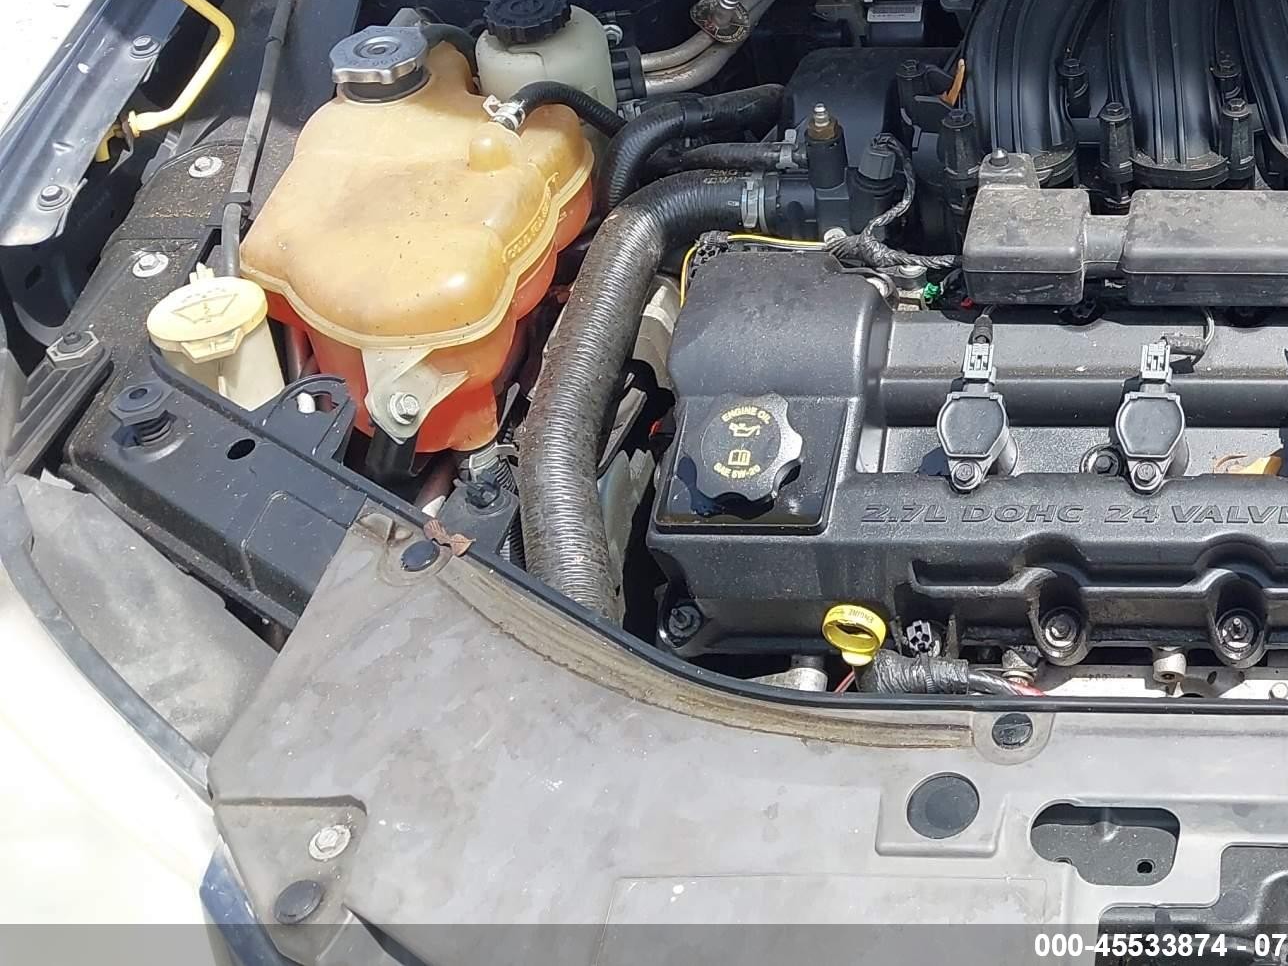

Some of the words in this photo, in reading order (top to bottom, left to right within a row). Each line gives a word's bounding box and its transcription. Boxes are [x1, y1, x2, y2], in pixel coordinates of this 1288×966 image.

[721, 406, 758, 424] ENGINE
[757, 409, 773, 425] OIL
[861, 503, 948, 524] 2.7L
[961, 503, 1085, 524] DOHC
[1104, 503, 1161, 524] 24
